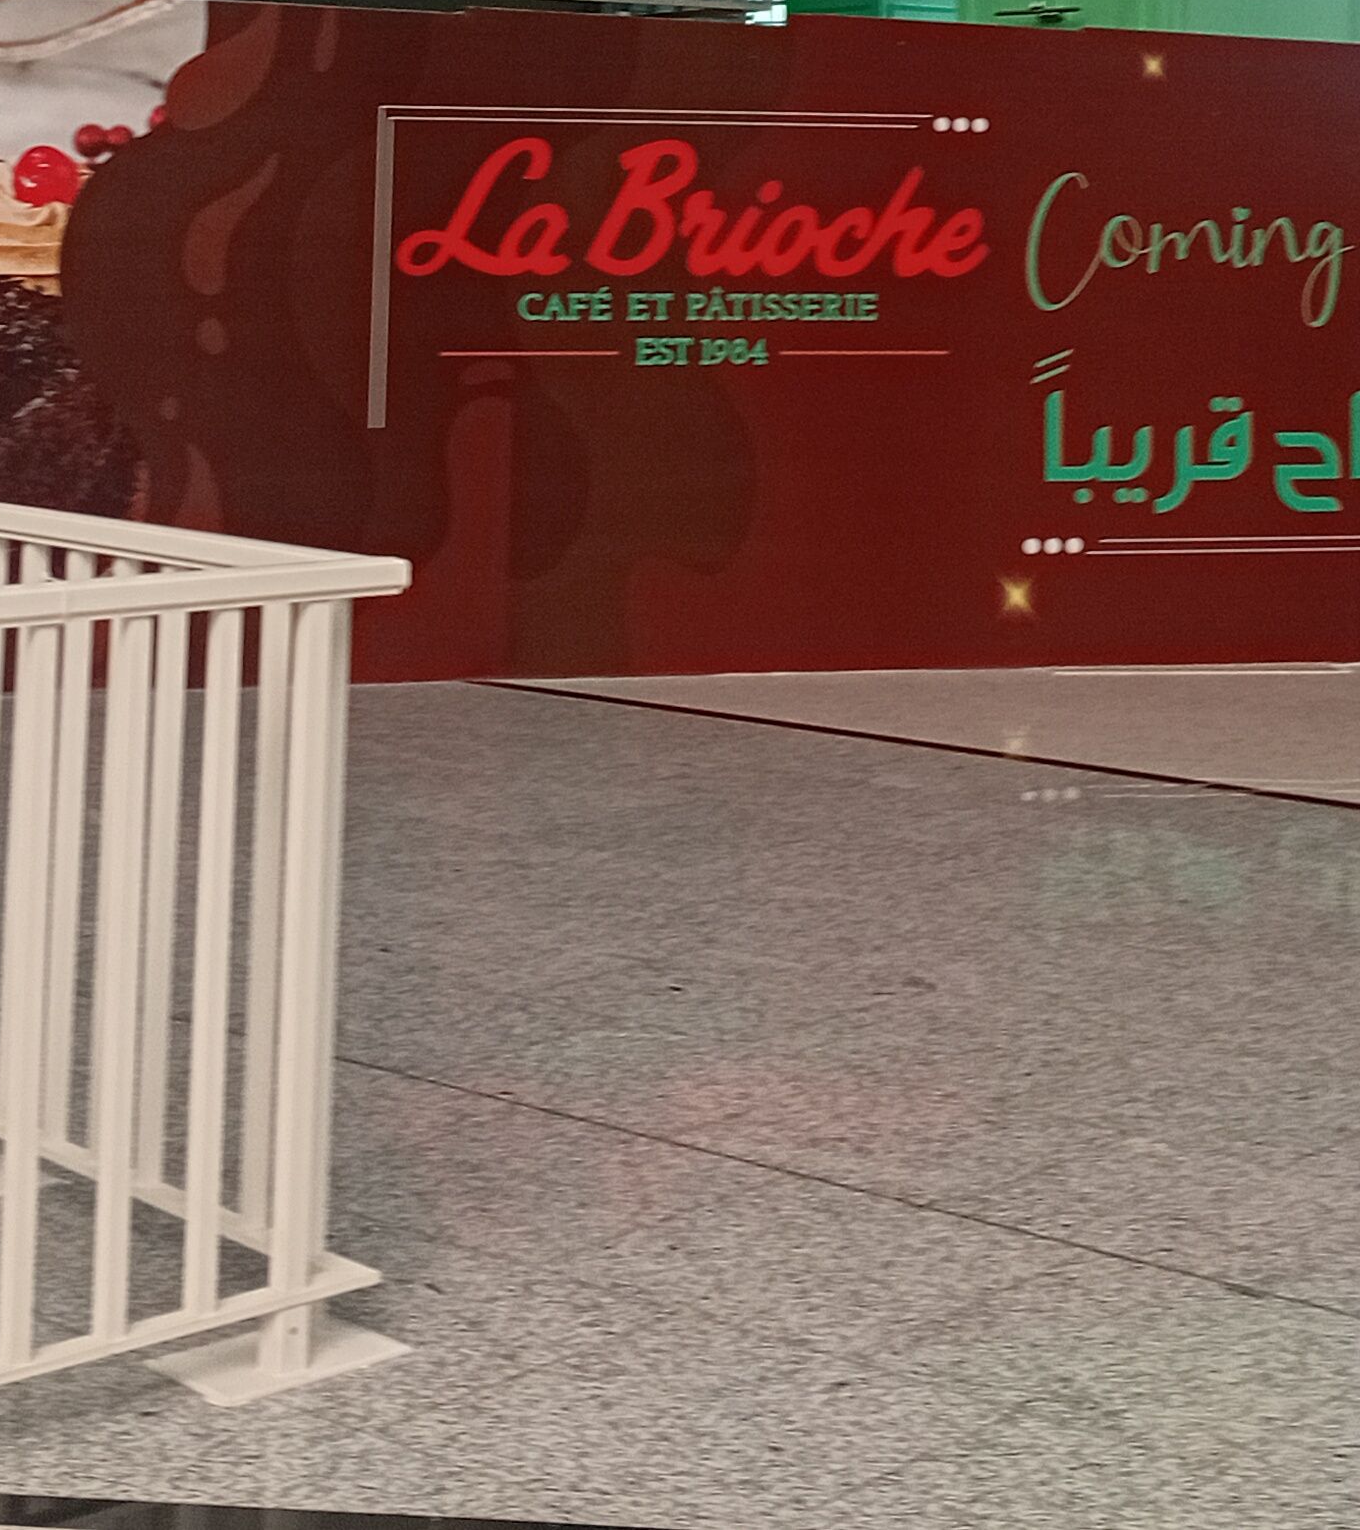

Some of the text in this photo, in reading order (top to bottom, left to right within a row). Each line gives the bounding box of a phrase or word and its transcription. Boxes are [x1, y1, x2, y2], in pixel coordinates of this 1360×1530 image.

[396, 136, 988, 279] La Brioche
[1025, 172, 1355, 328] Coming
[517, 286, 879, 323] CAFÉ ET PÂTISSERIE
[634, 337, 769, 366] EST 1984
